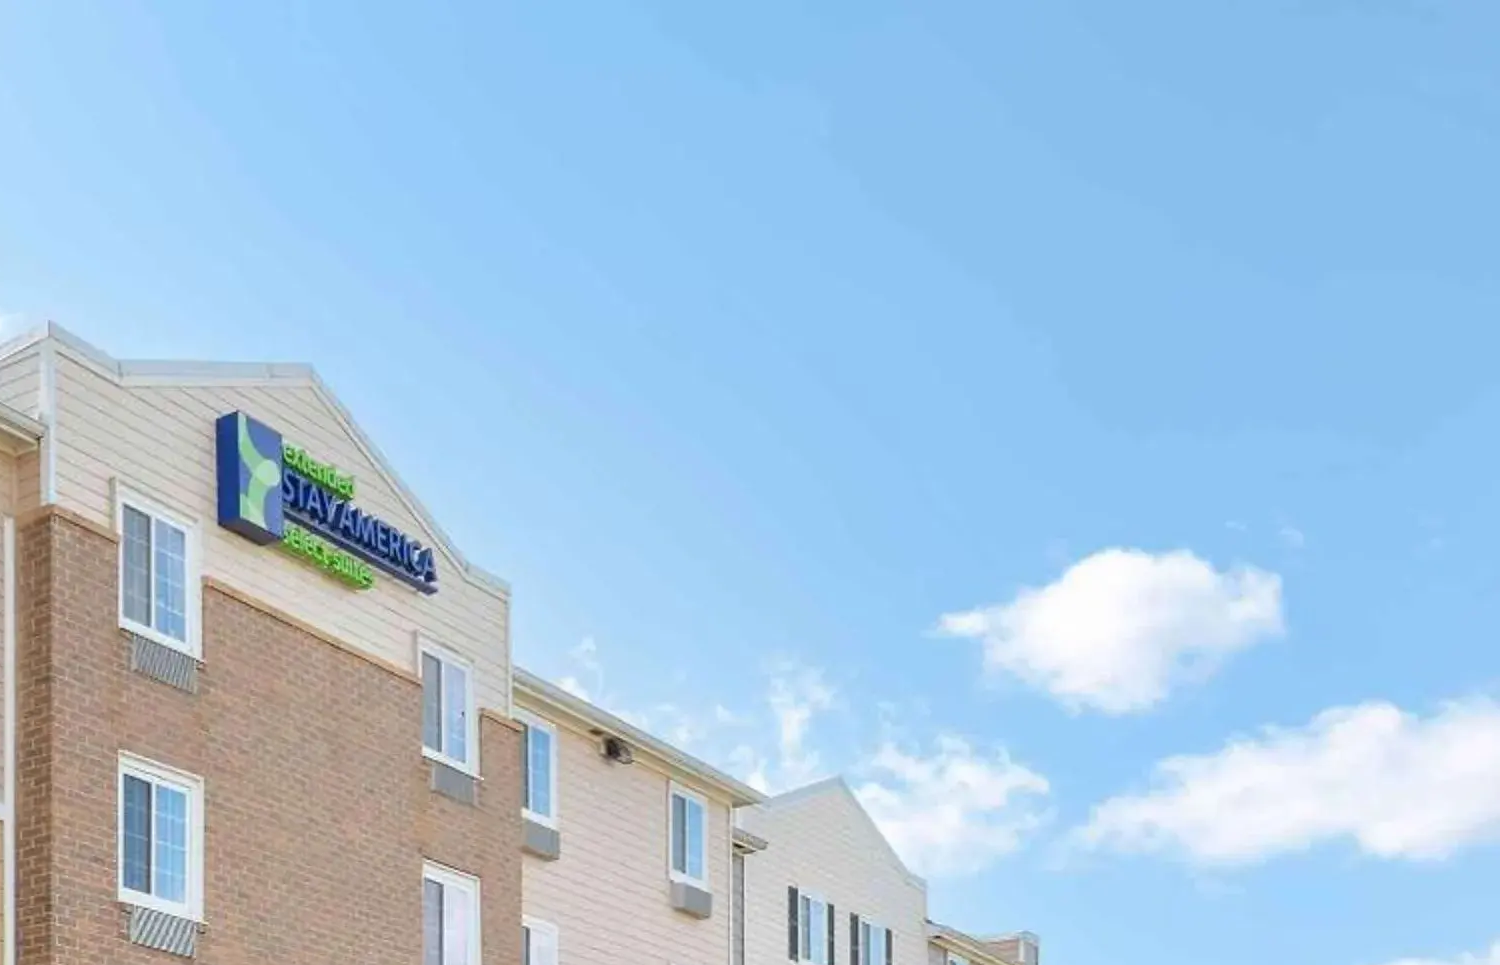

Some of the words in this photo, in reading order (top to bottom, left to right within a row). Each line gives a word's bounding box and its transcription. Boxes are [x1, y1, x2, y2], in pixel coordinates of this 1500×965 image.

[283, 446, 354, 499] extended
[282, 467, 344, 525] STAY
[340, 503, 437, 582] AMERICA
